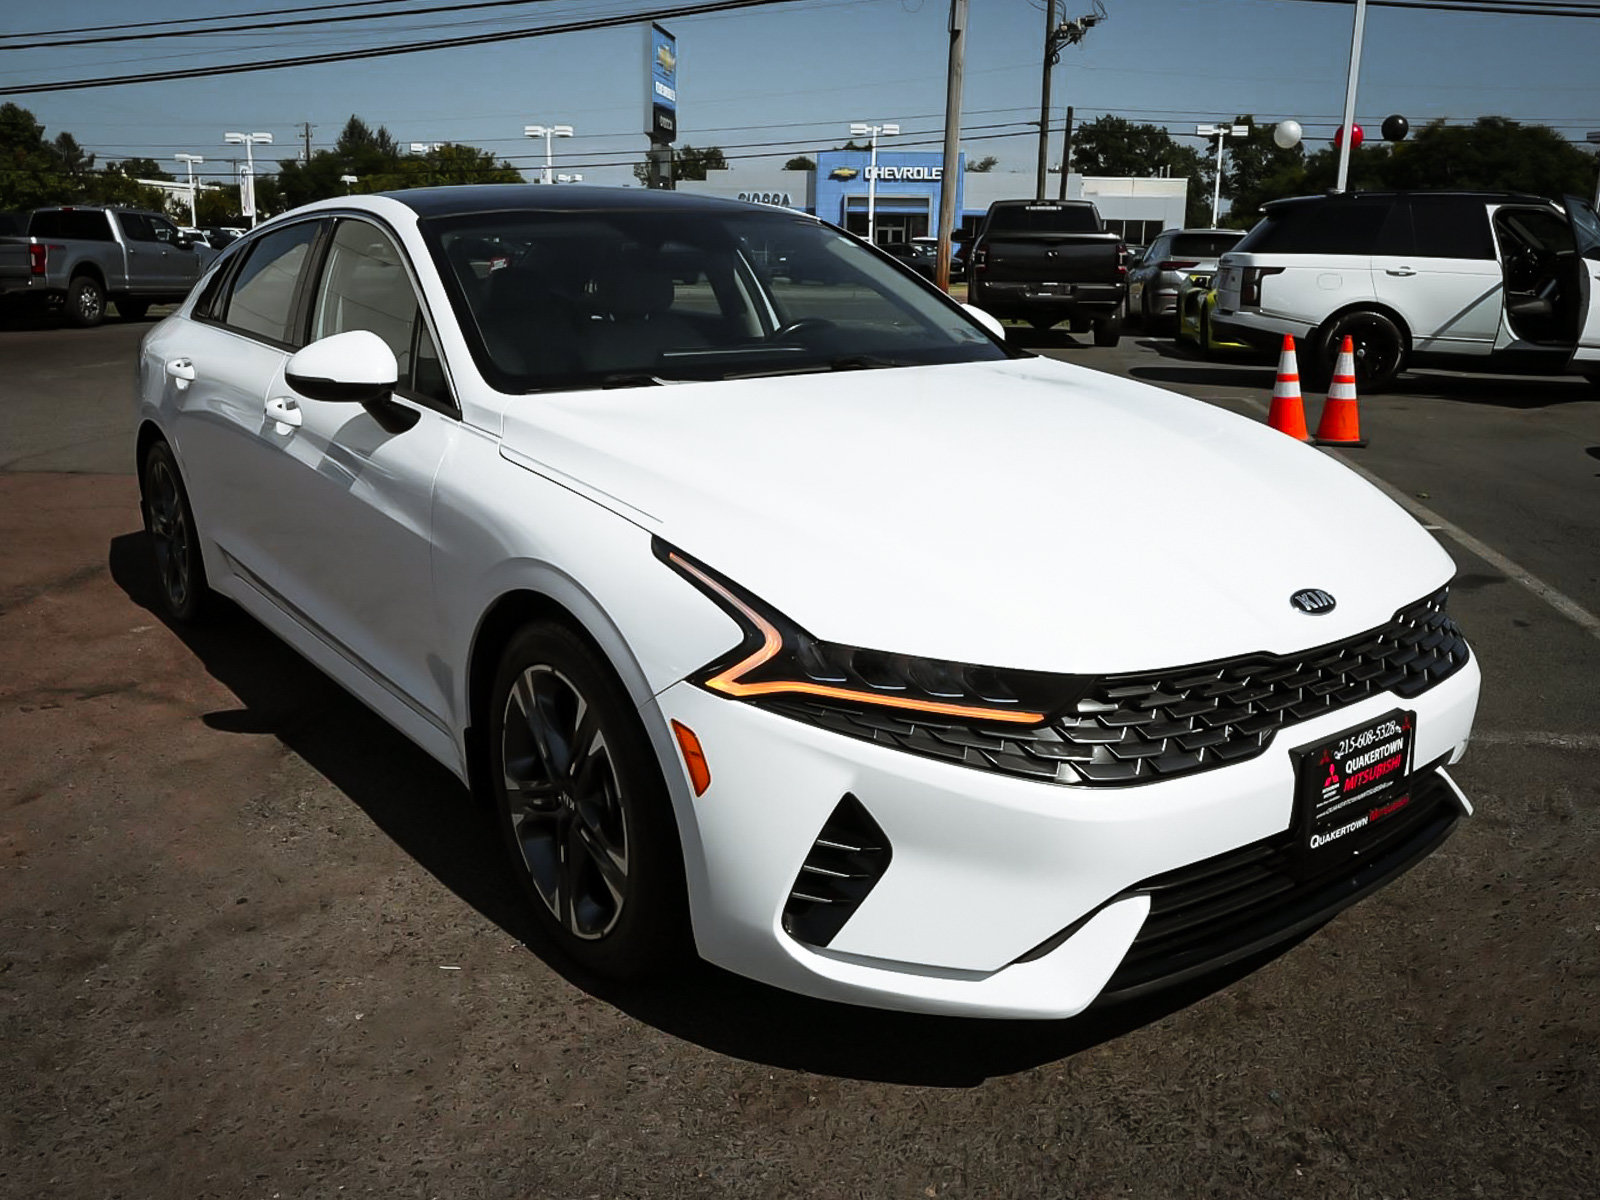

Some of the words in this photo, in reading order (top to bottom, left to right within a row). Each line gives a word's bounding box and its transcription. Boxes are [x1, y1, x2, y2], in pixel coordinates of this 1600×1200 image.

[864, 166, 944, 180] CHEVROLE
[1339, 720, 1396, 755] 215-608-5328
[1343, 754, 1402, 792] MITSUBISHI
[1345, 738, 1404, 774] QUAKERTOWN
